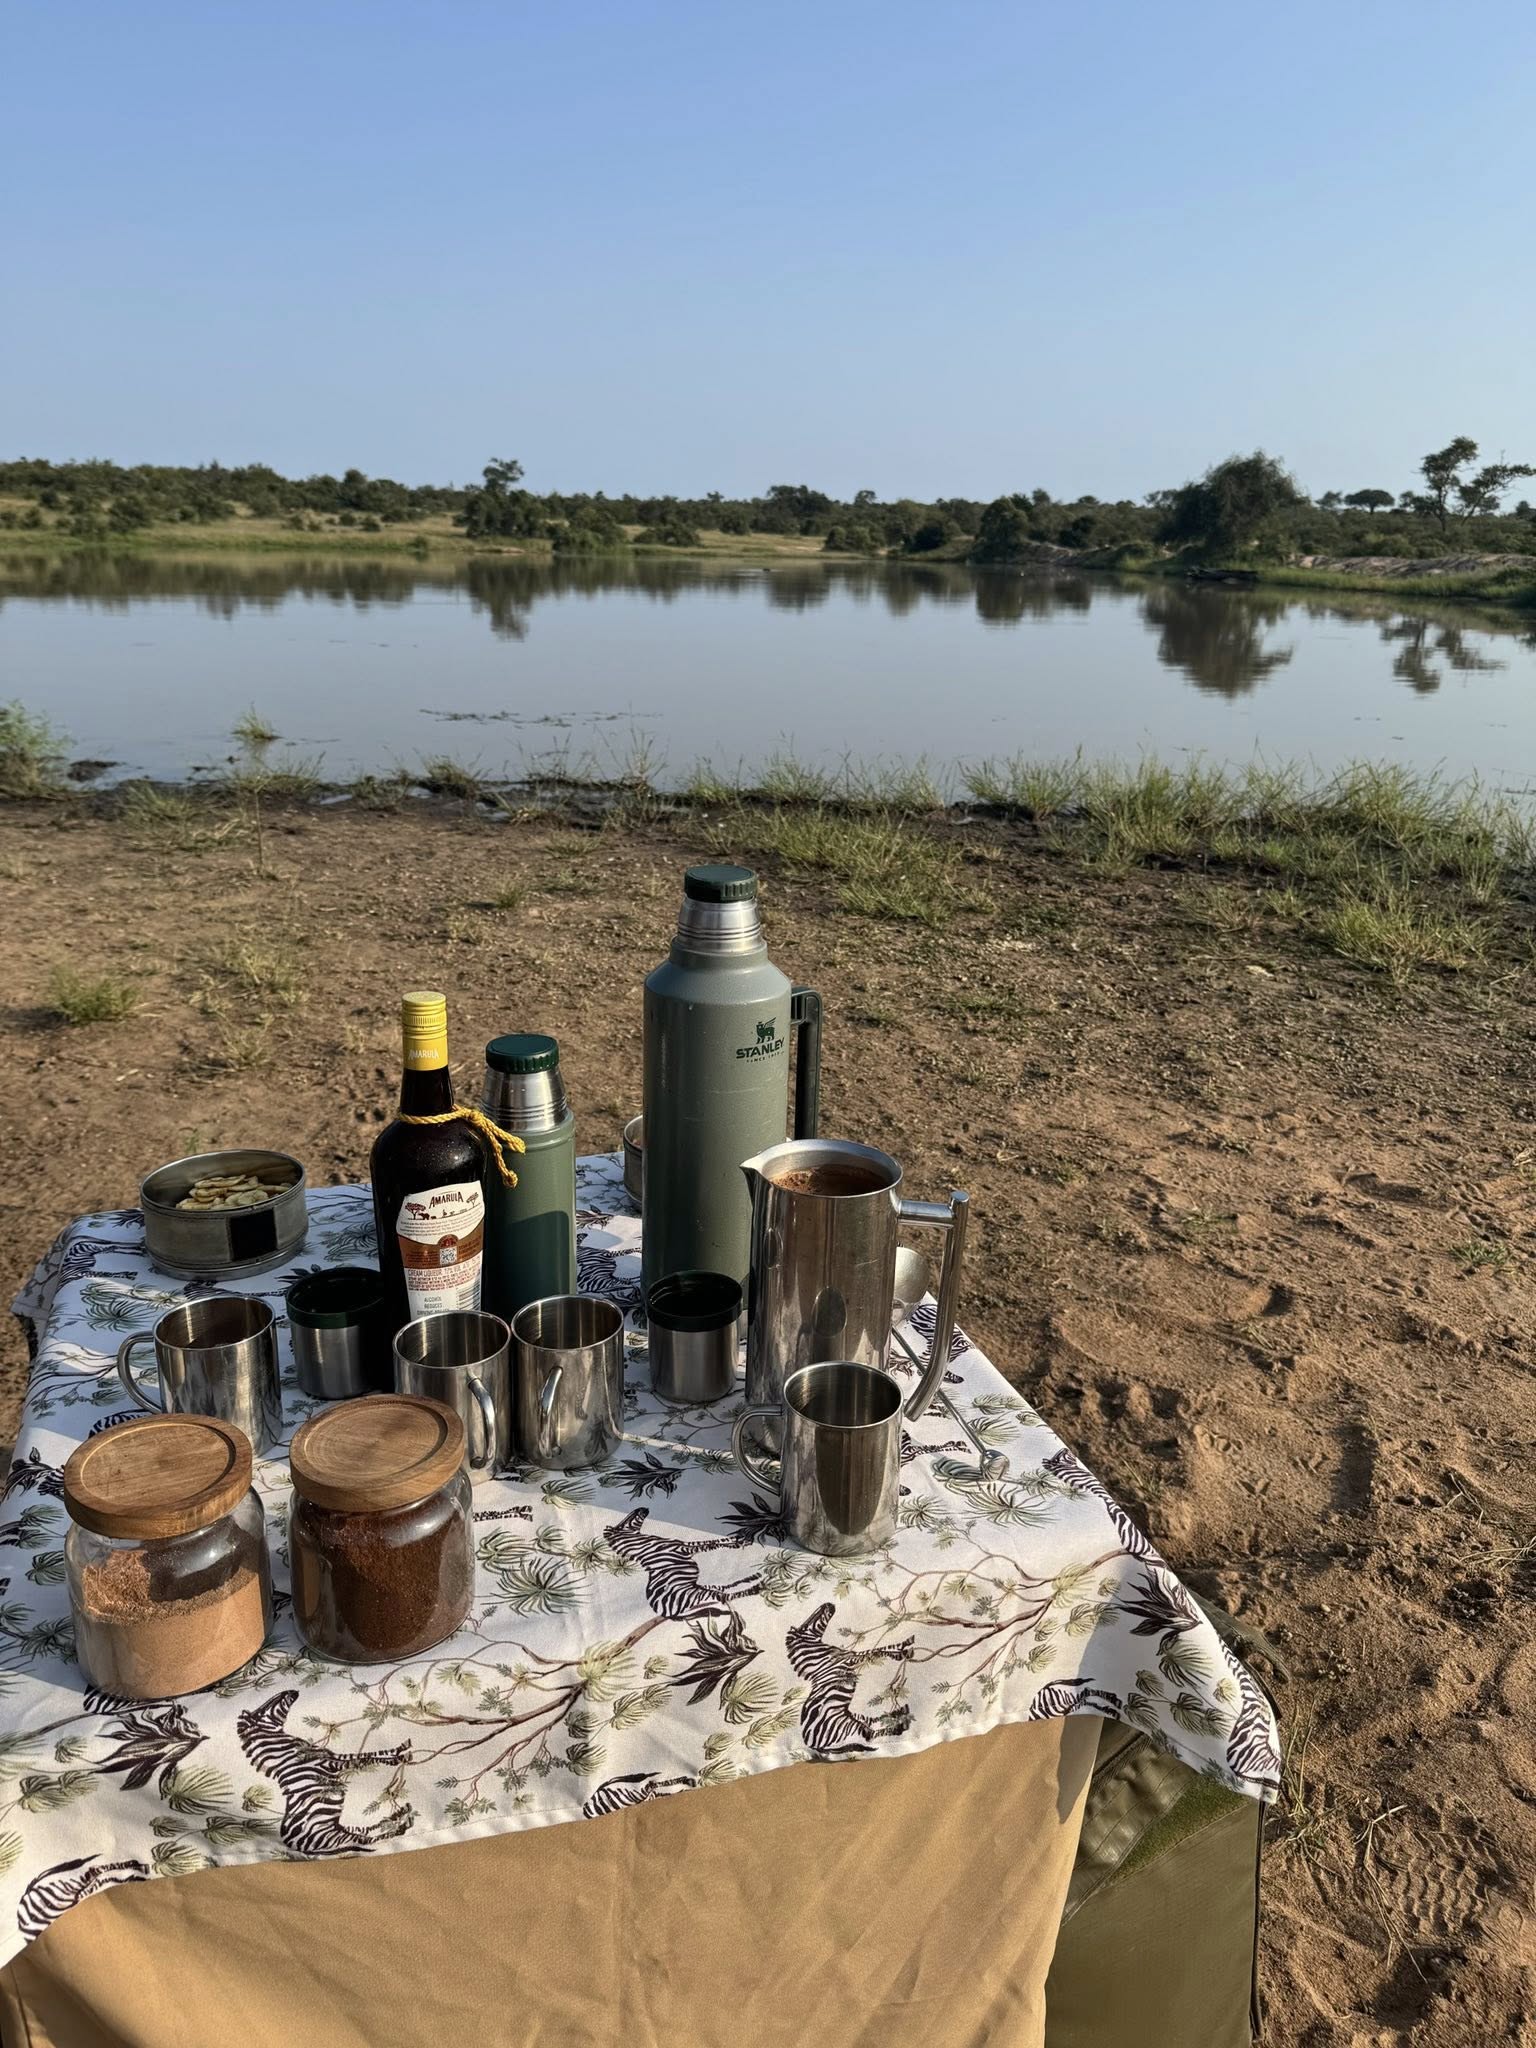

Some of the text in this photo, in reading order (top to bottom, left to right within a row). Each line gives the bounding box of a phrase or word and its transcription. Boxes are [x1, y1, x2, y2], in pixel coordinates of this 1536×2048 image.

[408, 1048, 439, 1060] AMARULA
[736, 1037, 785, 1059] STANLEY
[429, 1191, 464, 1209] AMARULA
